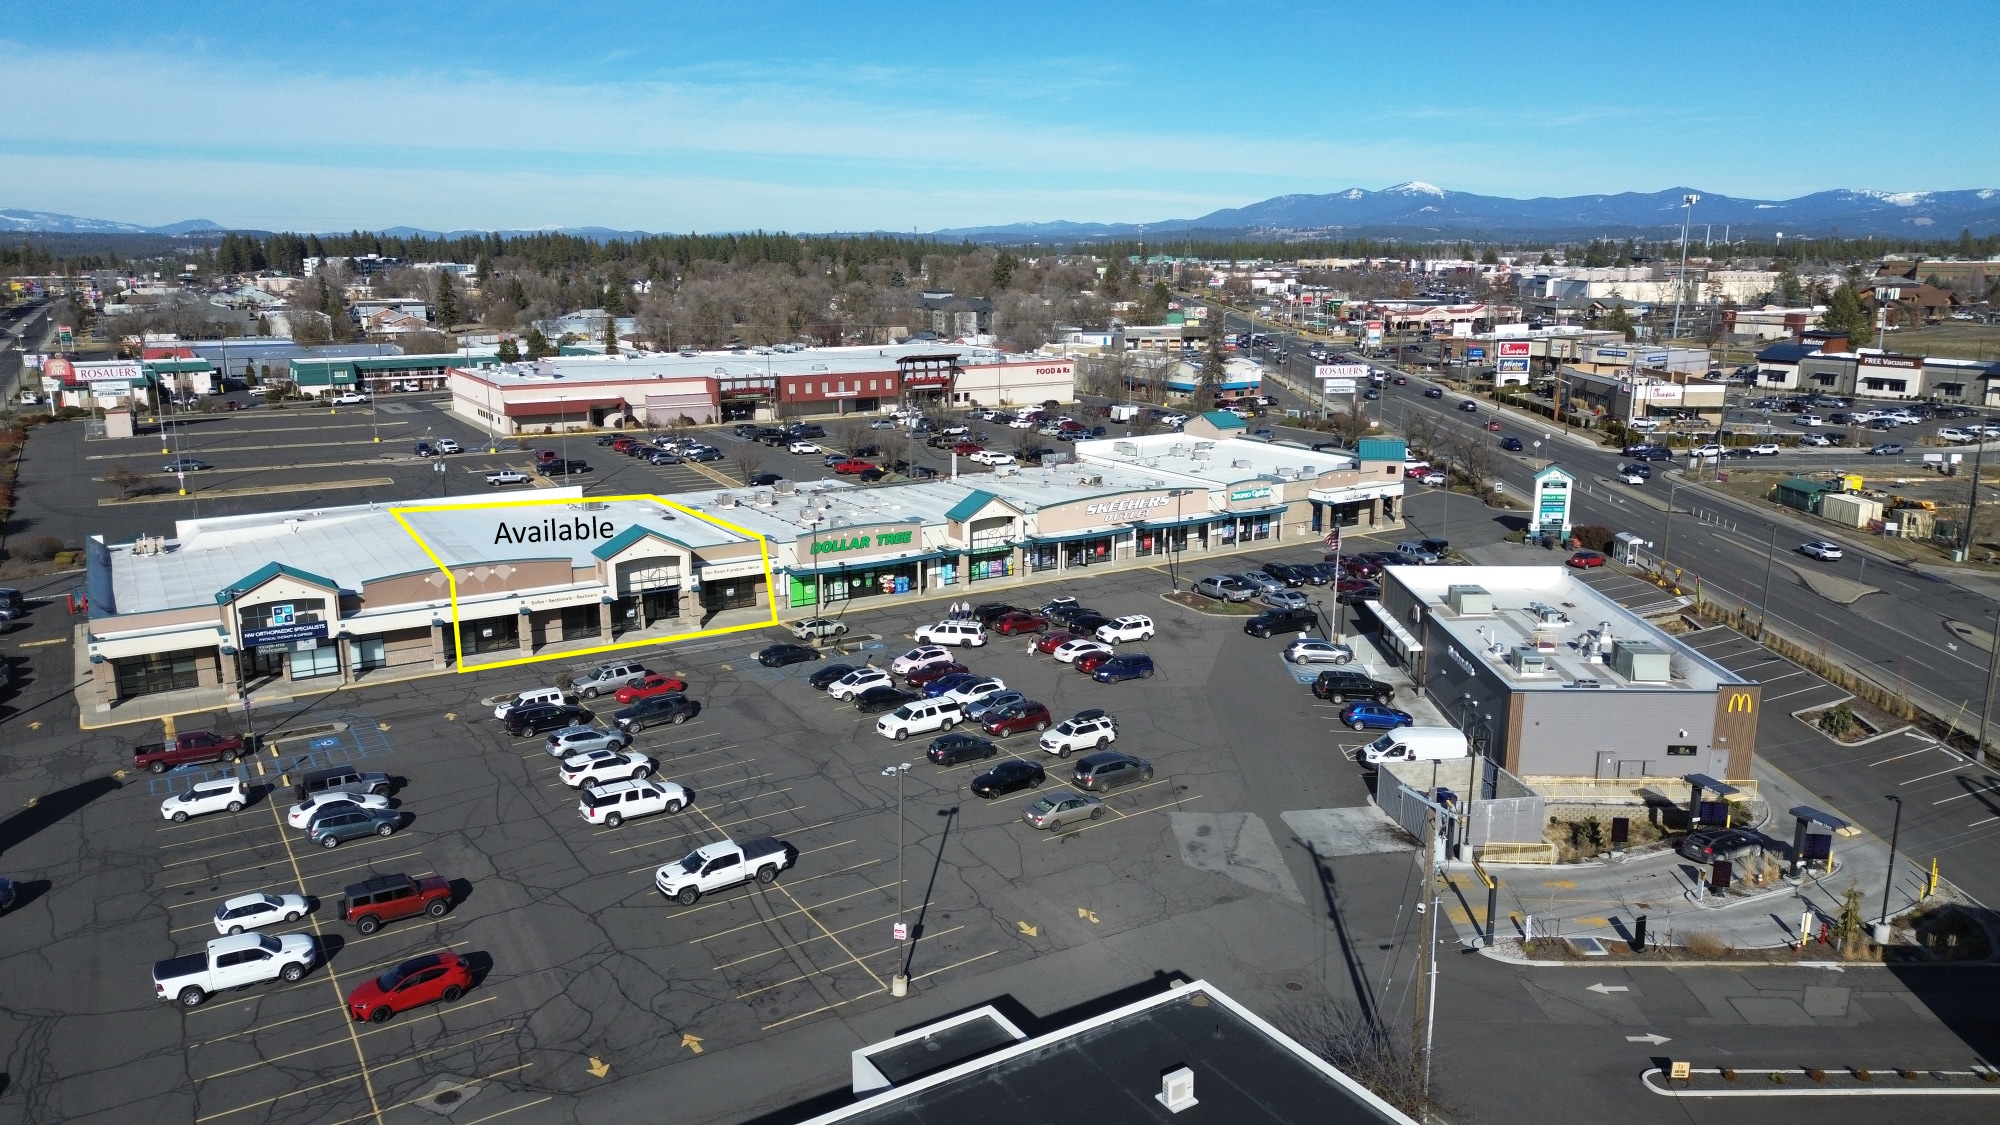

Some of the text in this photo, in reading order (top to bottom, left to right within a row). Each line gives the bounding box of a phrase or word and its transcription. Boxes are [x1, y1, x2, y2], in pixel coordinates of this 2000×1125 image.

[1802, 338, 1826, 346] Mister
[1864, 357, 1914, 367] FREE Vacuums
[80, 367, 137, 379] ROSAUERS
[1036, 366, 1070, 375] FOOD & Rx
[1319, 367, 1363, 376] ROSAUERS
[1085, 495, 1170, 516] SKECHERS
[1104, 509, 1151, 522] OUTLET
[810, 531, 913, 555] DOLLAR TREE
[244, 624, 326, 639] NW ORTHOPAEDIC SPECIALISTS
[258, 646, 289, 654] Welcome
